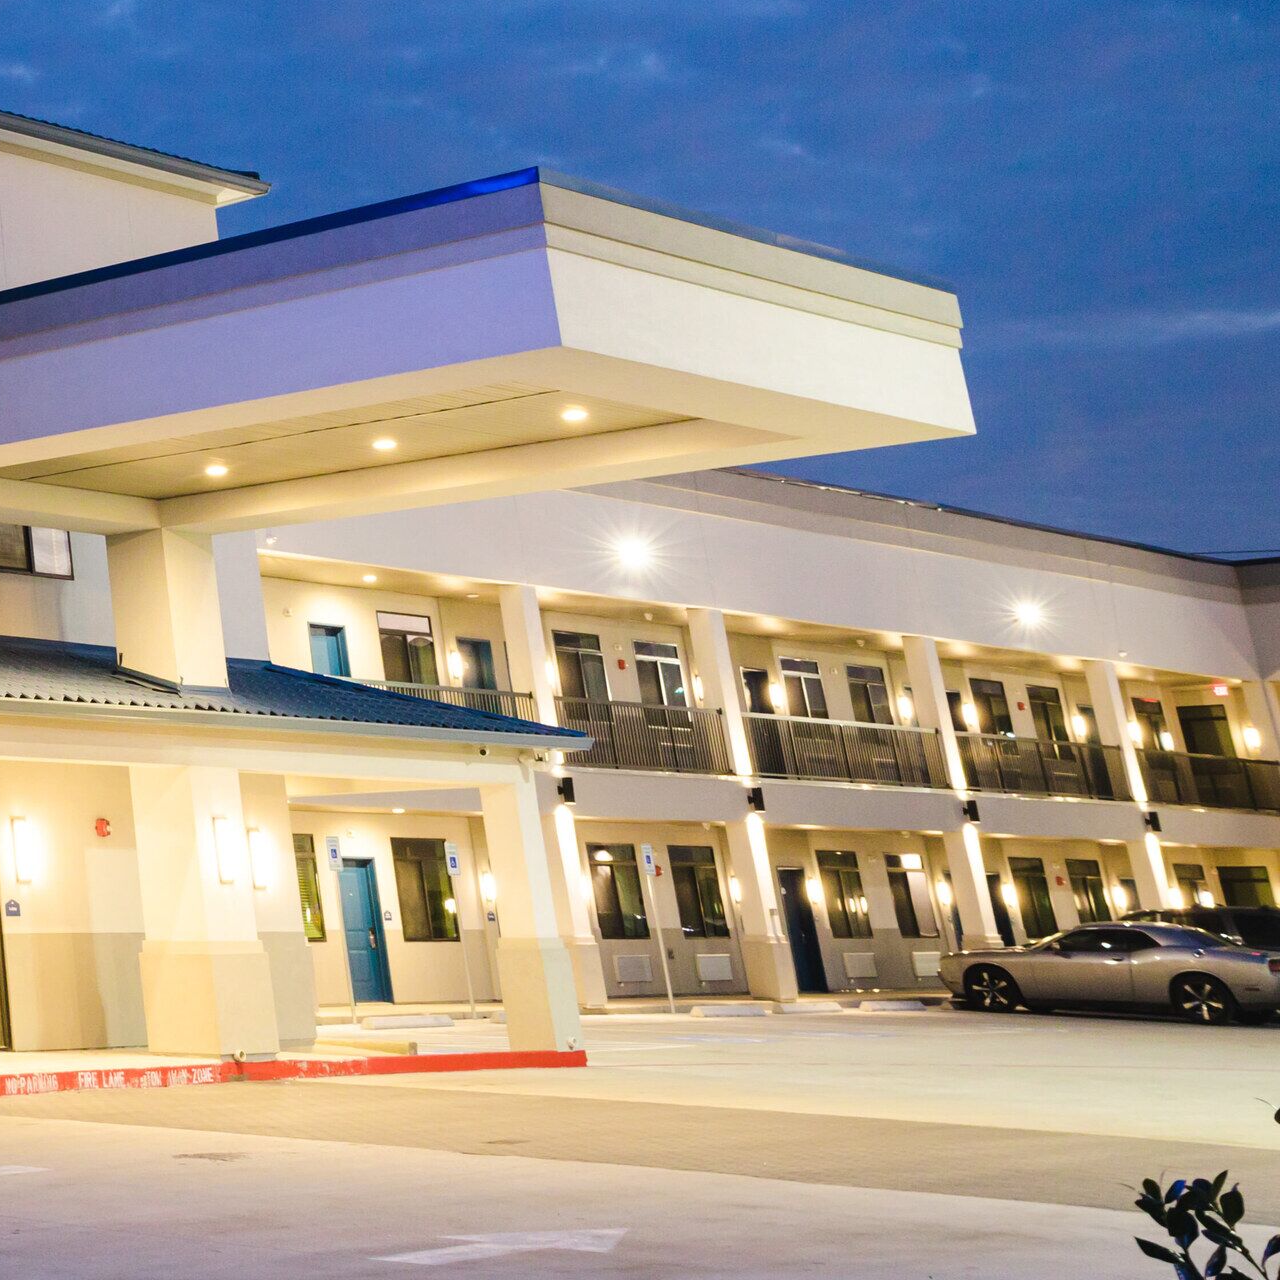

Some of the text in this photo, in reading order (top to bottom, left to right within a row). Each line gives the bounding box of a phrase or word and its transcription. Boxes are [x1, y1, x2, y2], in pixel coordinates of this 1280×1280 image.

[78, 1071, 99, 1089] FIRE
[102, 1071, 125, 1088] LANE
[192, 1067, 214, 1084] ZONE
